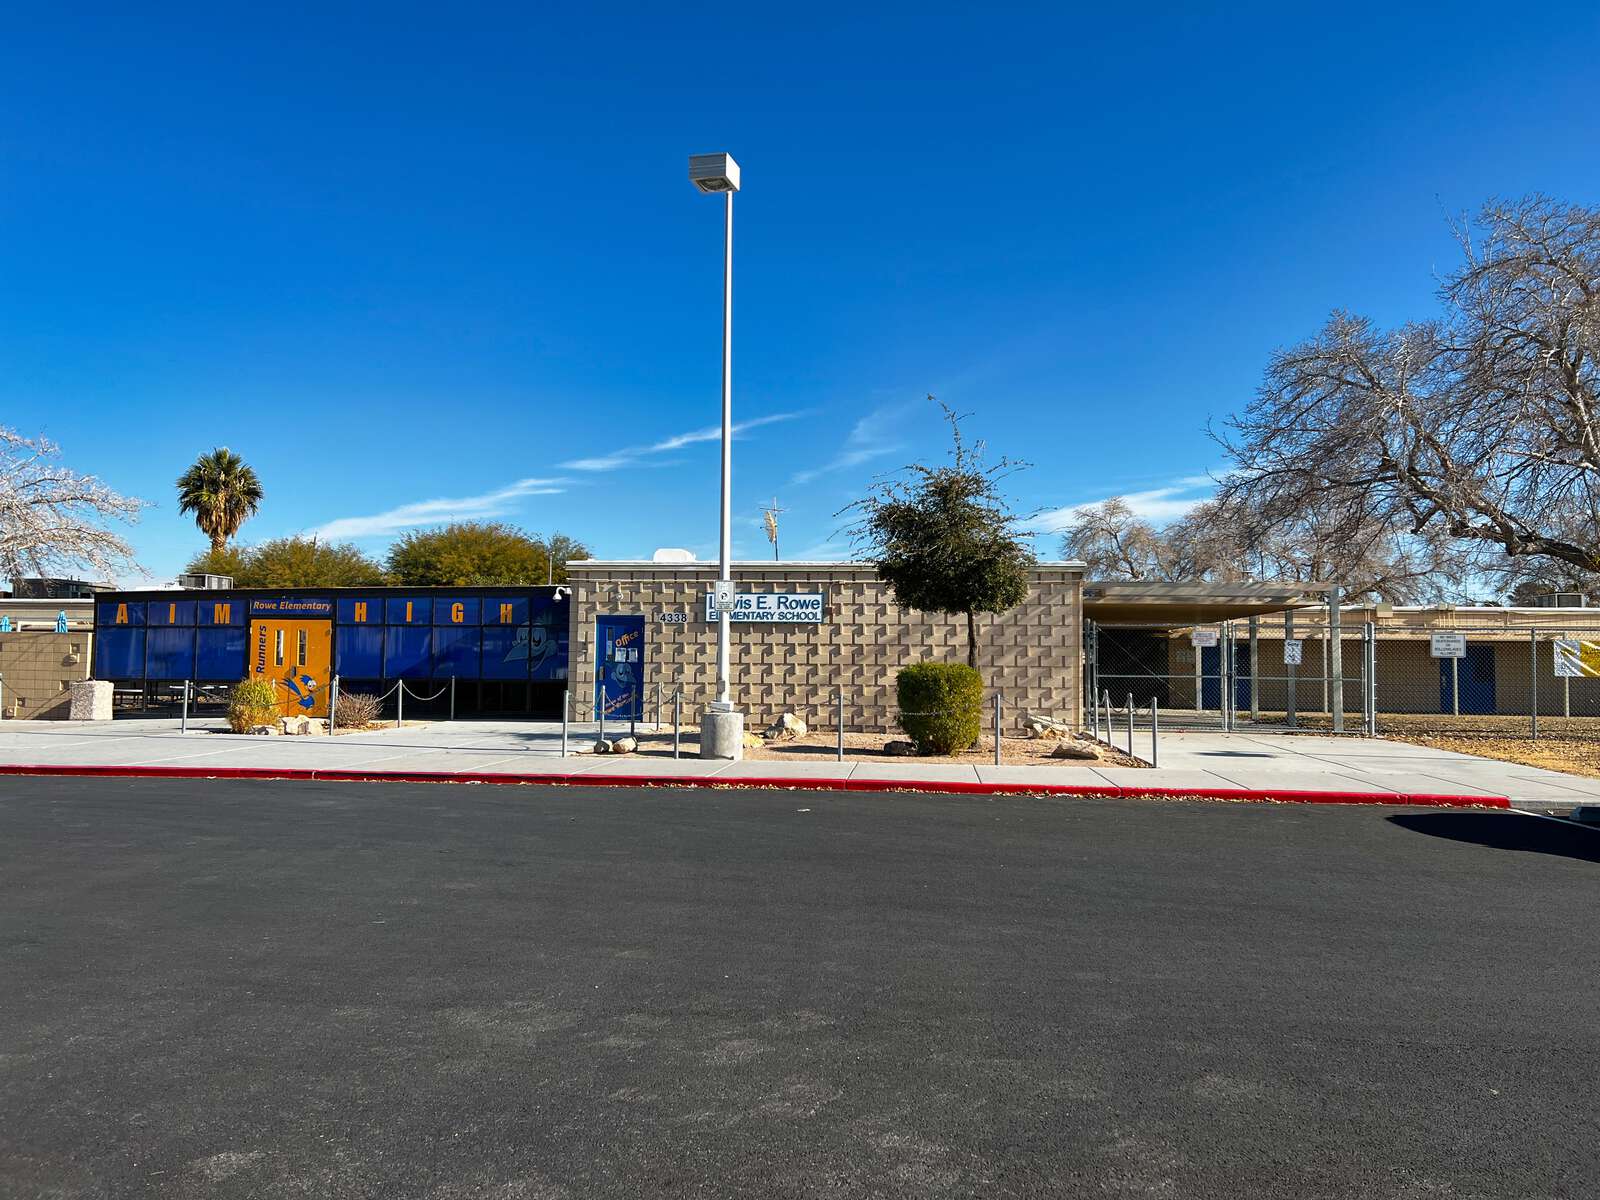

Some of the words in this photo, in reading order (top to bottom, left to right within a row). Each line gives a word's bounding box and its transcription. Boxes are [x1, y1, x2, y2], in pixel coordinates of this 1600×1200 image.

[253, 601, 277, 610] Rowe
[279, 601, 332, 611] Elementary
[756, 595, 772, 610] E.
[777, 595, 821, 610] Rowe
[659, 613, 688, 623] 4338
[708, 611, 776, 621] ELMENTARY
[777, 611, 821, 621] SCHOOL
[615, 631, 640, 647] Office
[256, 625, 267, 674] Runners
